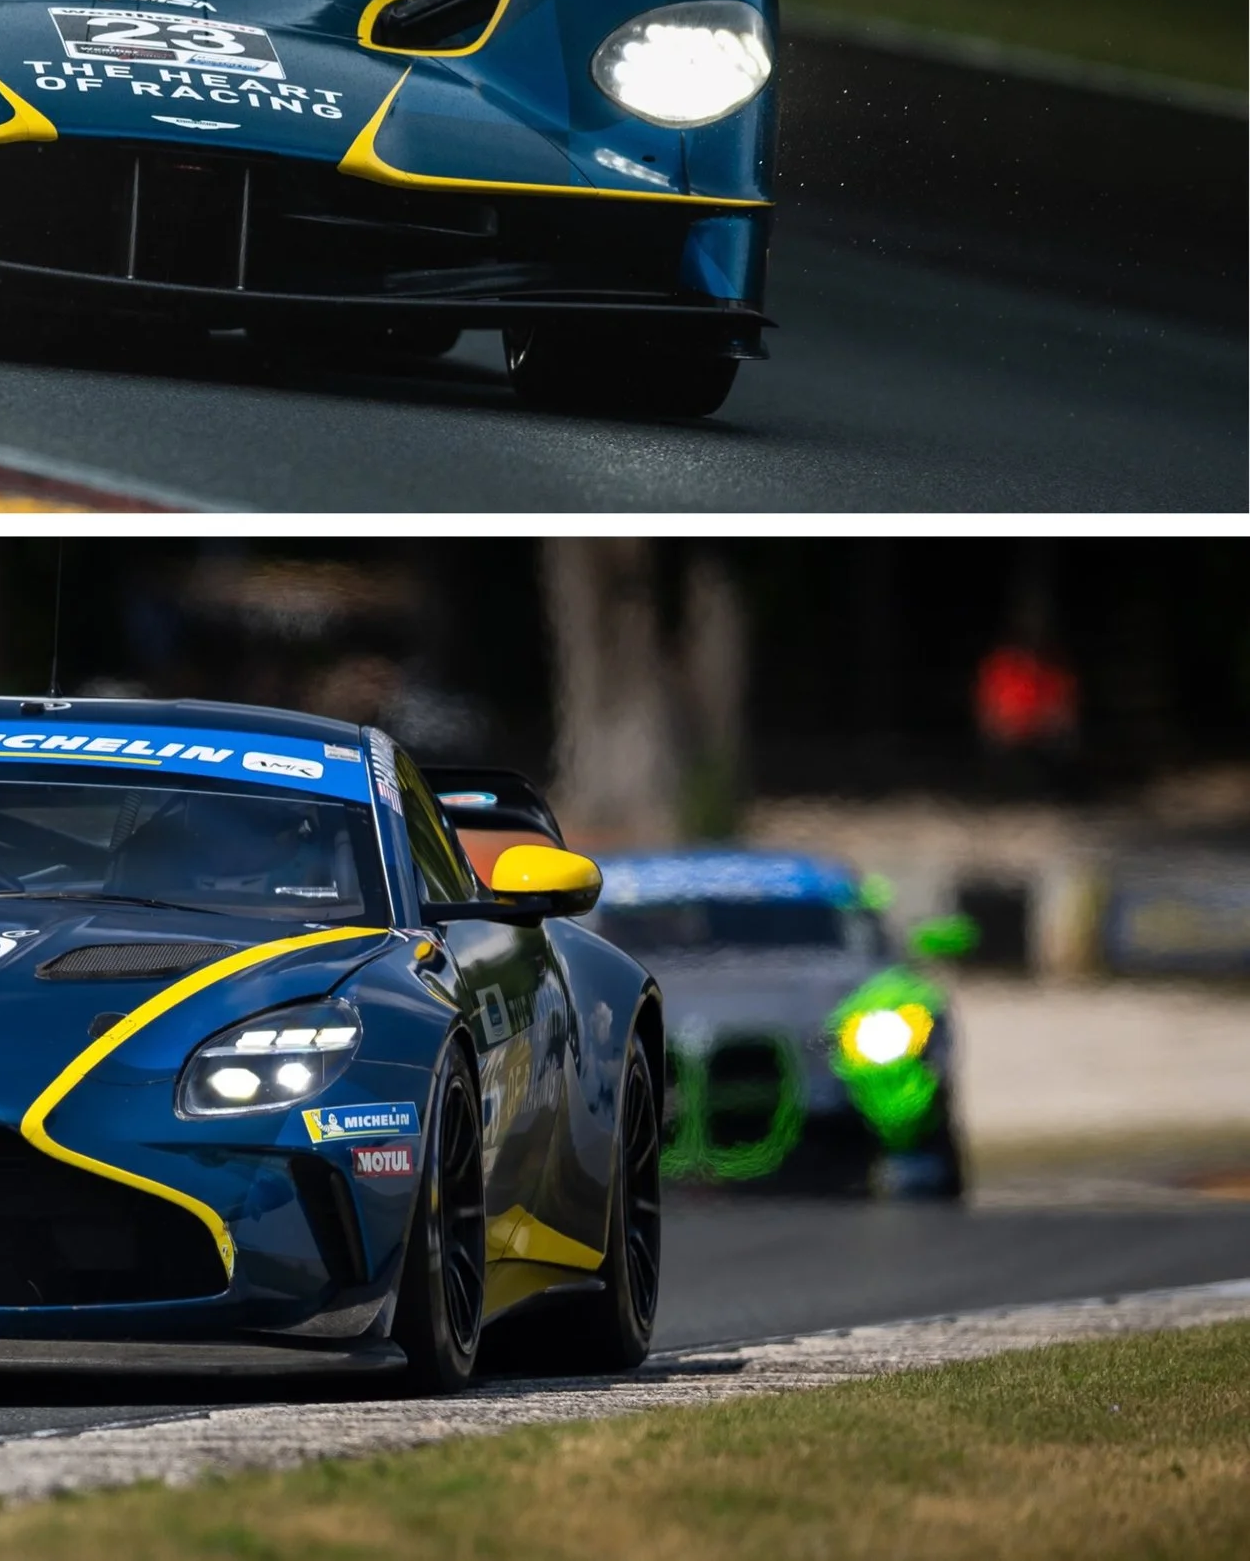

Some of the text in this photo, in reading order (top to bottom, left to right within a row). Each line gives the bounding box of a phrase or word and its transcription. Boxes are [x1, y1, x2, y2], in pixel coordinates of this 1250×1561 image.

[87, 18, 245, 54] 23
[23, 60, 343, 104] THE HEART
[36, 76, 343, 119] OF RACING
[344, 1113, 410, 1129] MICHELIN
[357, 1150, 410, 1172] MOTUL
